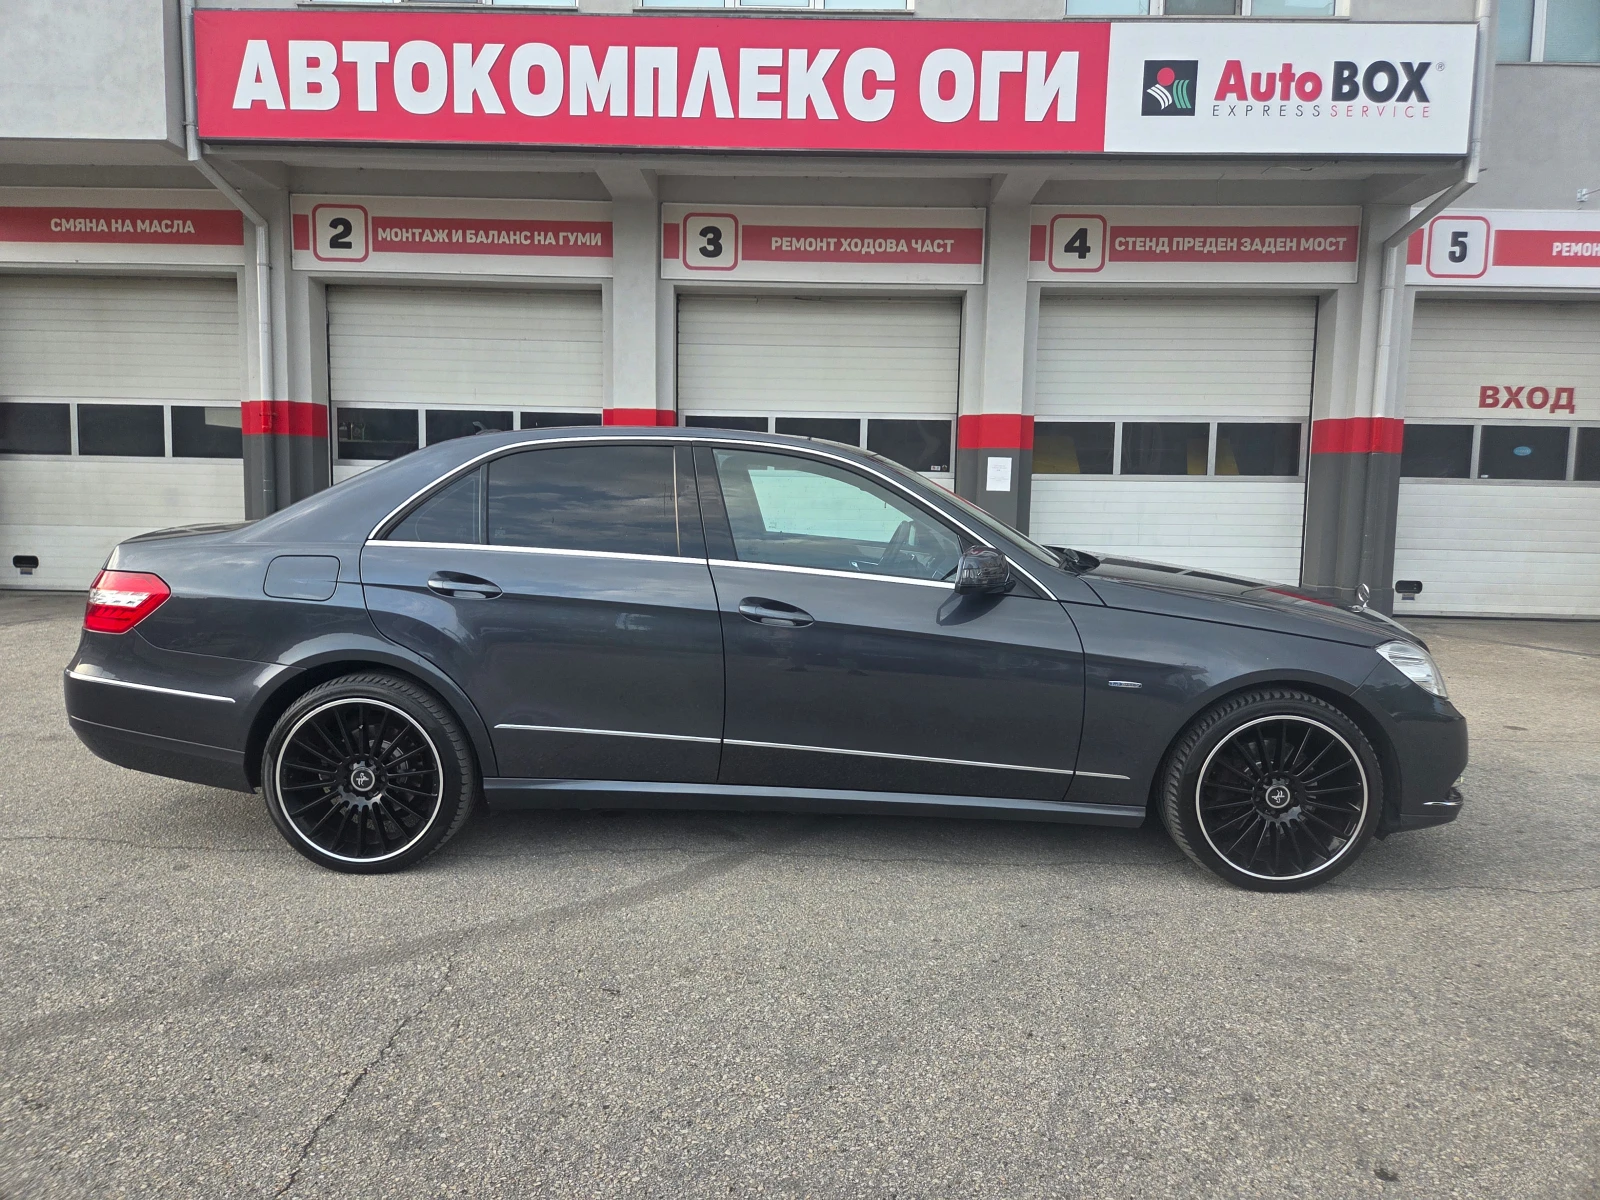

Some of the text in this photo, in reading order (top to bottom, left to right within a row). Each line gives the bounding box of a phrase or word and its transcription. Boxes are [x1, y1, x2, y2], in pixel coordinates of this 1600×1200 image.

[232, 39, 1080, 123] АВТОКОМПЛЕКС ОГИ
[1213, 59, 1432, 103] Auto BOX
[1212, 104, 1430, 118] EXPRESS SERVICE
[50, 218, 195, 234] СМЯНА НА МАСЛА
[329, 217, 352, 249] 2
[377, 227, 602, 246] МОНТАЖ И БАЛАНС НА ГУМИ
[699, 226, 723, 258] 3
[771, 237, 954, 255] РЕМОНТ ХОДОВА ЧАСТ
[1064, 228, 1091, 259] 4
[1114, 237, 1347, 254] СТЕНД ПРЕДЕН ЗАДЕН МОСТ
[1448, 231, 1468, 263] 5
[1478, 385, 1576, 414] ВХОД
